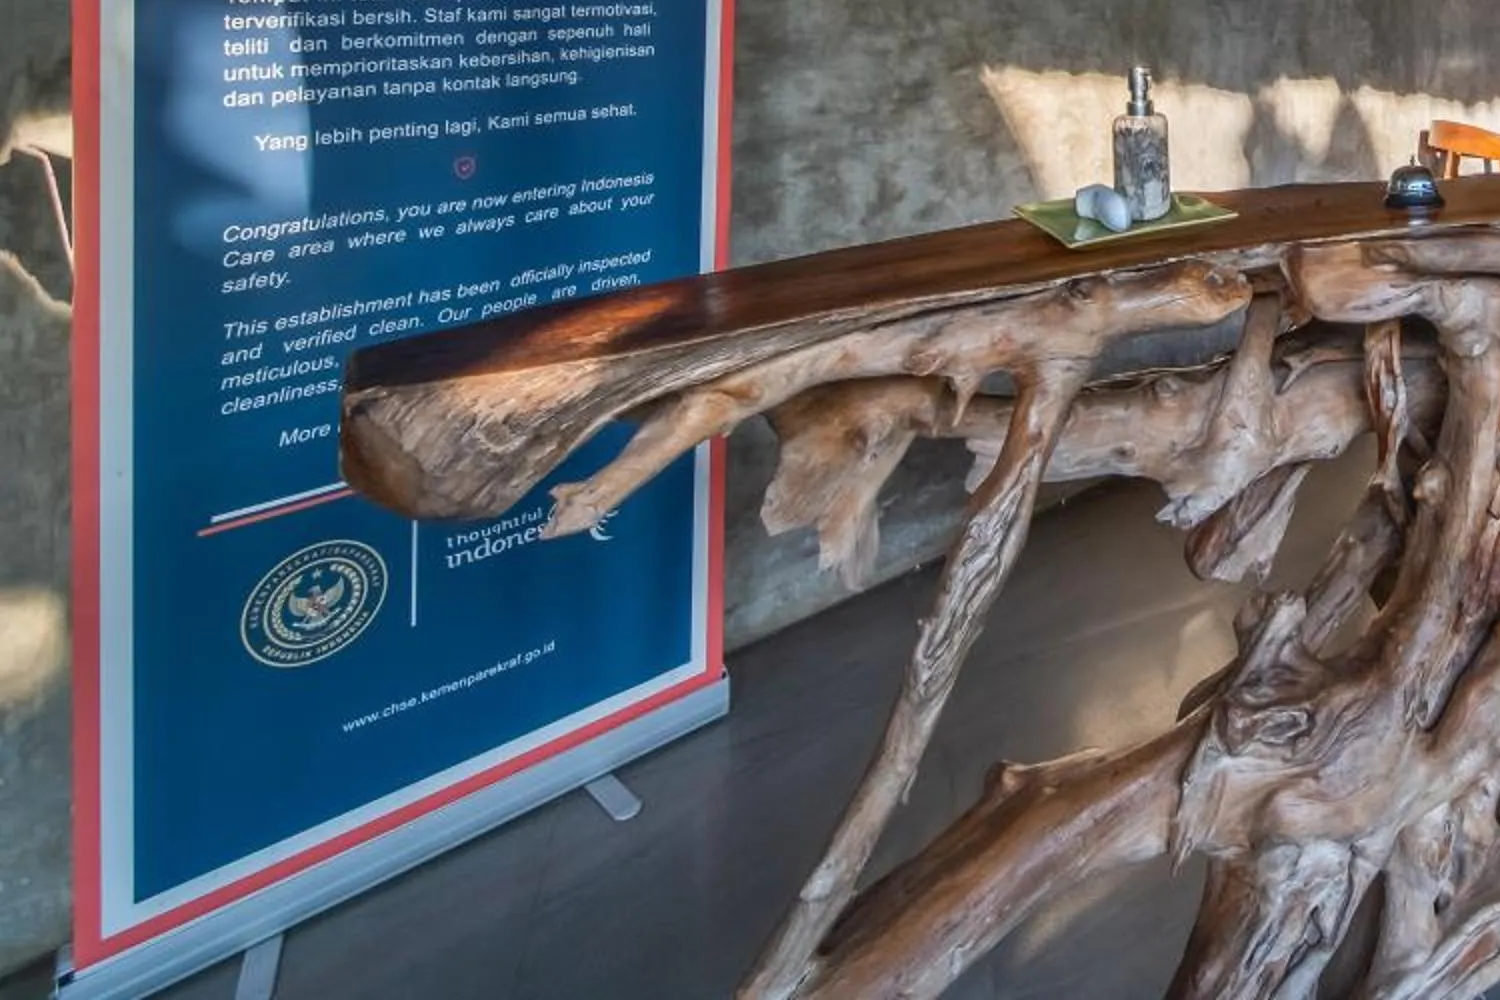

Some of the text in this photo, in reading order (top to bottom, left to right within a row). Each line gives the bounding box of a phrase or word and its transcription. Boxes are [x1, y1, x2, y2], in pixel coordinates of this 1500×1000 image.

[224, 11, 346, 30] terverifikasi
[353, 9, 416, 25] bersih.
[425, 7, 462, 23] Staf
[467, 7, 507, 22] kami
[513, 5, 565, 23] sangat
[224, 23, 651, 56] teliti dan berkomitmen dengan sepenuh hati
[224, 63, 284, 82] untuk
[291, 55, 452, 77] memprioritaskan
[560, 44, 655, 63] kehigienisan
[223, 90, 264, 108] dan
[271, 83, 377, 106] pelayanan
[384, 79, 436, 99] tanpa
[442, 75, 500, 92] kontak
[255, 103, 637, 152] Yang lebih penting lagi, Kami semua sehat.
[223, 171, 655, 244] Congratulations, you are now entering Indonesia
[223, 193, 655, 268] Care area where we always care about your
[221, 270, 291, 294] safety.
[223, 250, 651, 340] This establishment has been officially inspected
[221, 345, 262, 366] and
[283, 327, 356, 353] verified
[369, 314, 424, 336] clean.
[438, 307, 471, 323] Our
[481, 290, 538, 320] people
[552, 285, 577, 300] are
[221, 377, 343, 416] cleanliness,
[279, 422, 331, 447] More
[446, 524, 546, 569] indones
[447, 507, 542, 547] thoughtful
[343, 640, 555, 733] www.chse.kemenparekraf.go.id
